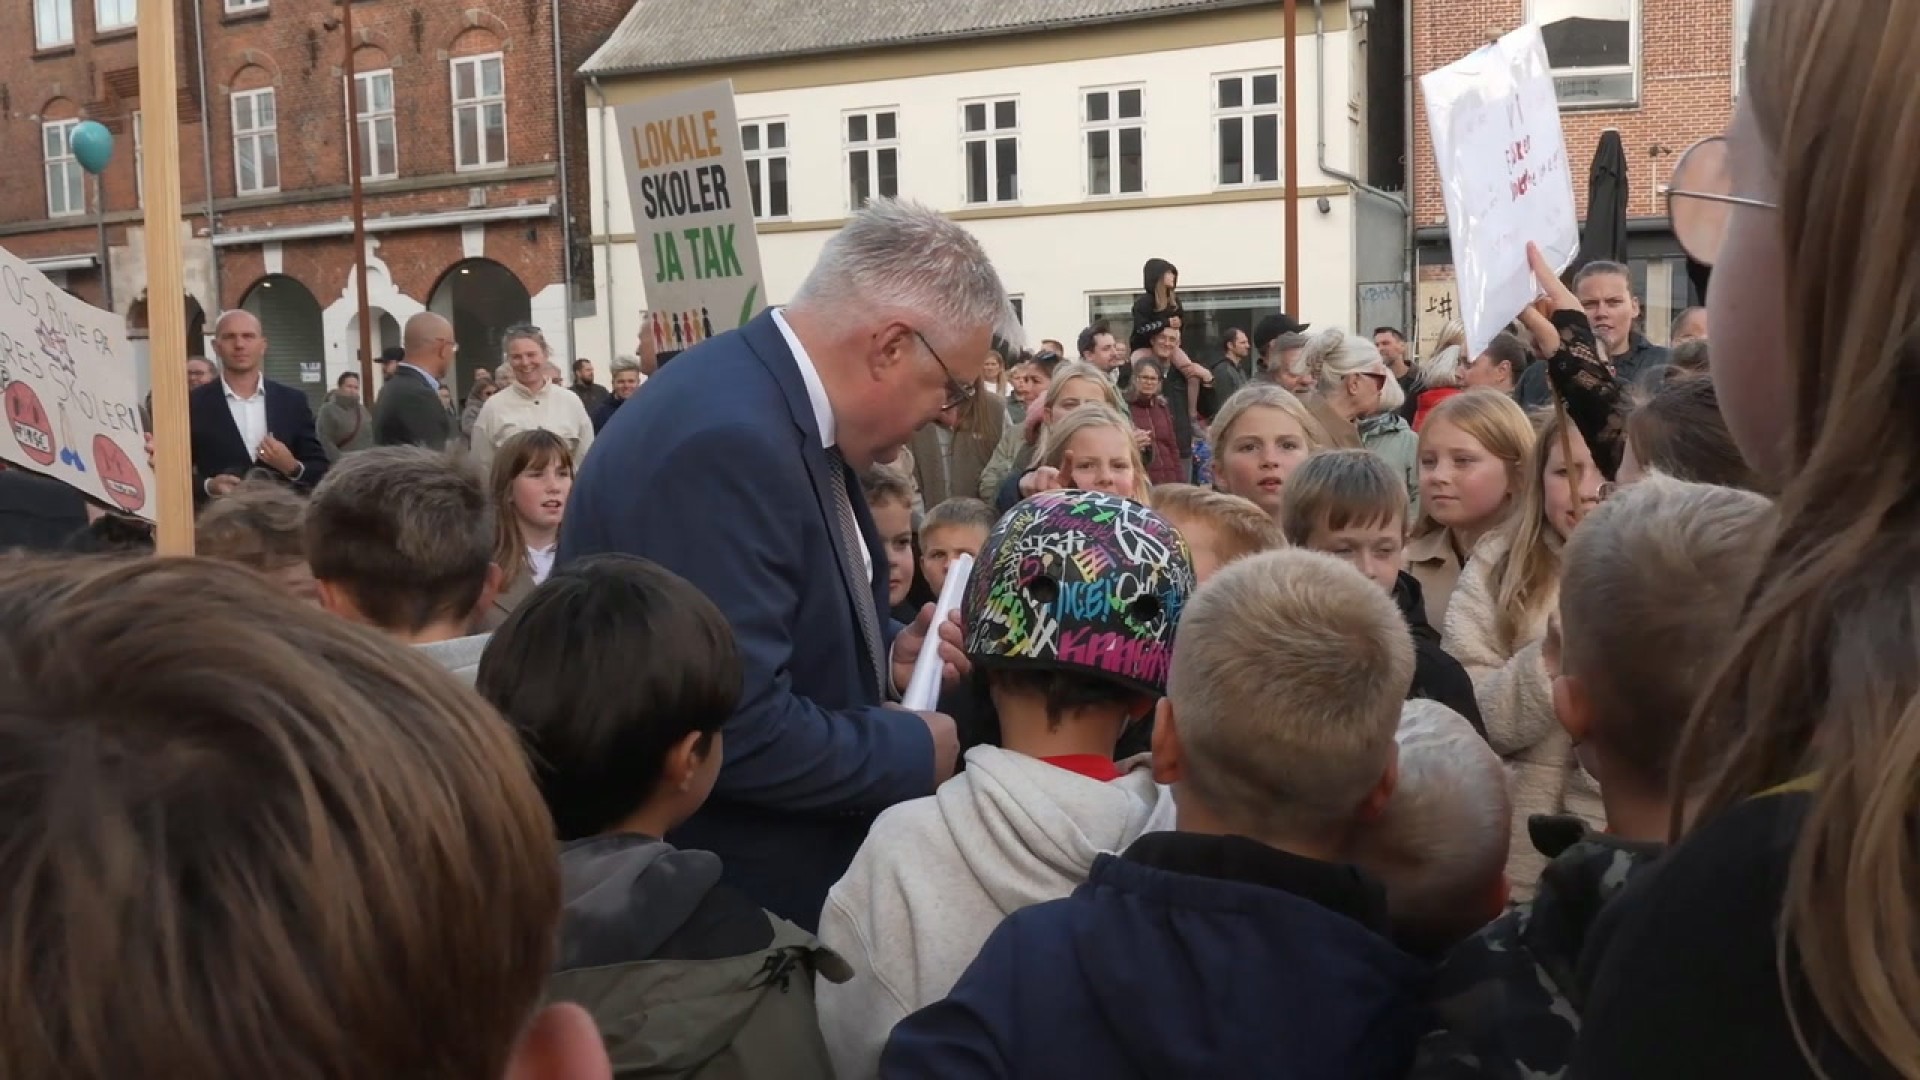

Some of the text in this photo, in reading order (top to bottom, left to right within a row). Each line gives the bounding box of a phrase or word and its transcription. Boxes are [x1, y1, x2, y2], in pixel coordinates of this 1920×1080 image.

[632, 110, 722, 169] LOKALE
[641, 164, 731, 219] SKOLER
[653, 223, 743, 283] JA TAK
[2, 265, 39, 317] OS
[0, 331, 44, 379] RES
